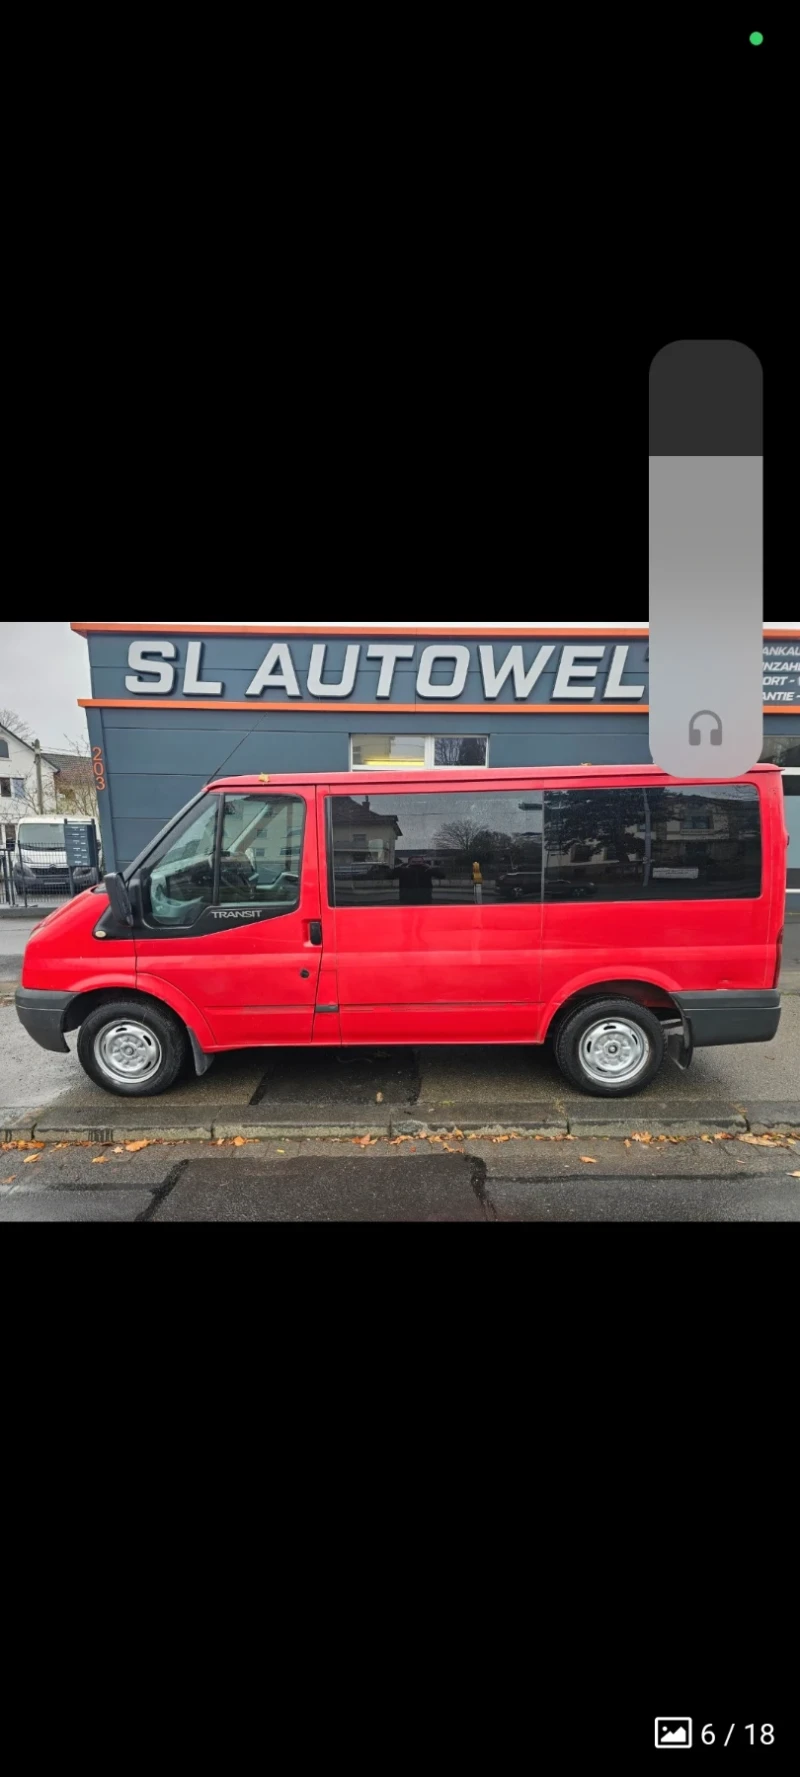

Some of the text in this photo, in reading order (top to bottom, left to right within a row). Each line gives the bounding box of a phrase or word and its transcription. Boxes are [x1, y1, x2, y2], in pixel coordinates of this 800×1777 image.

[124, 640, 647, 700] SL AUTOWEL
[92, 746, 106, 791] 203
[211, 910, 262, 919] TRANSIT
